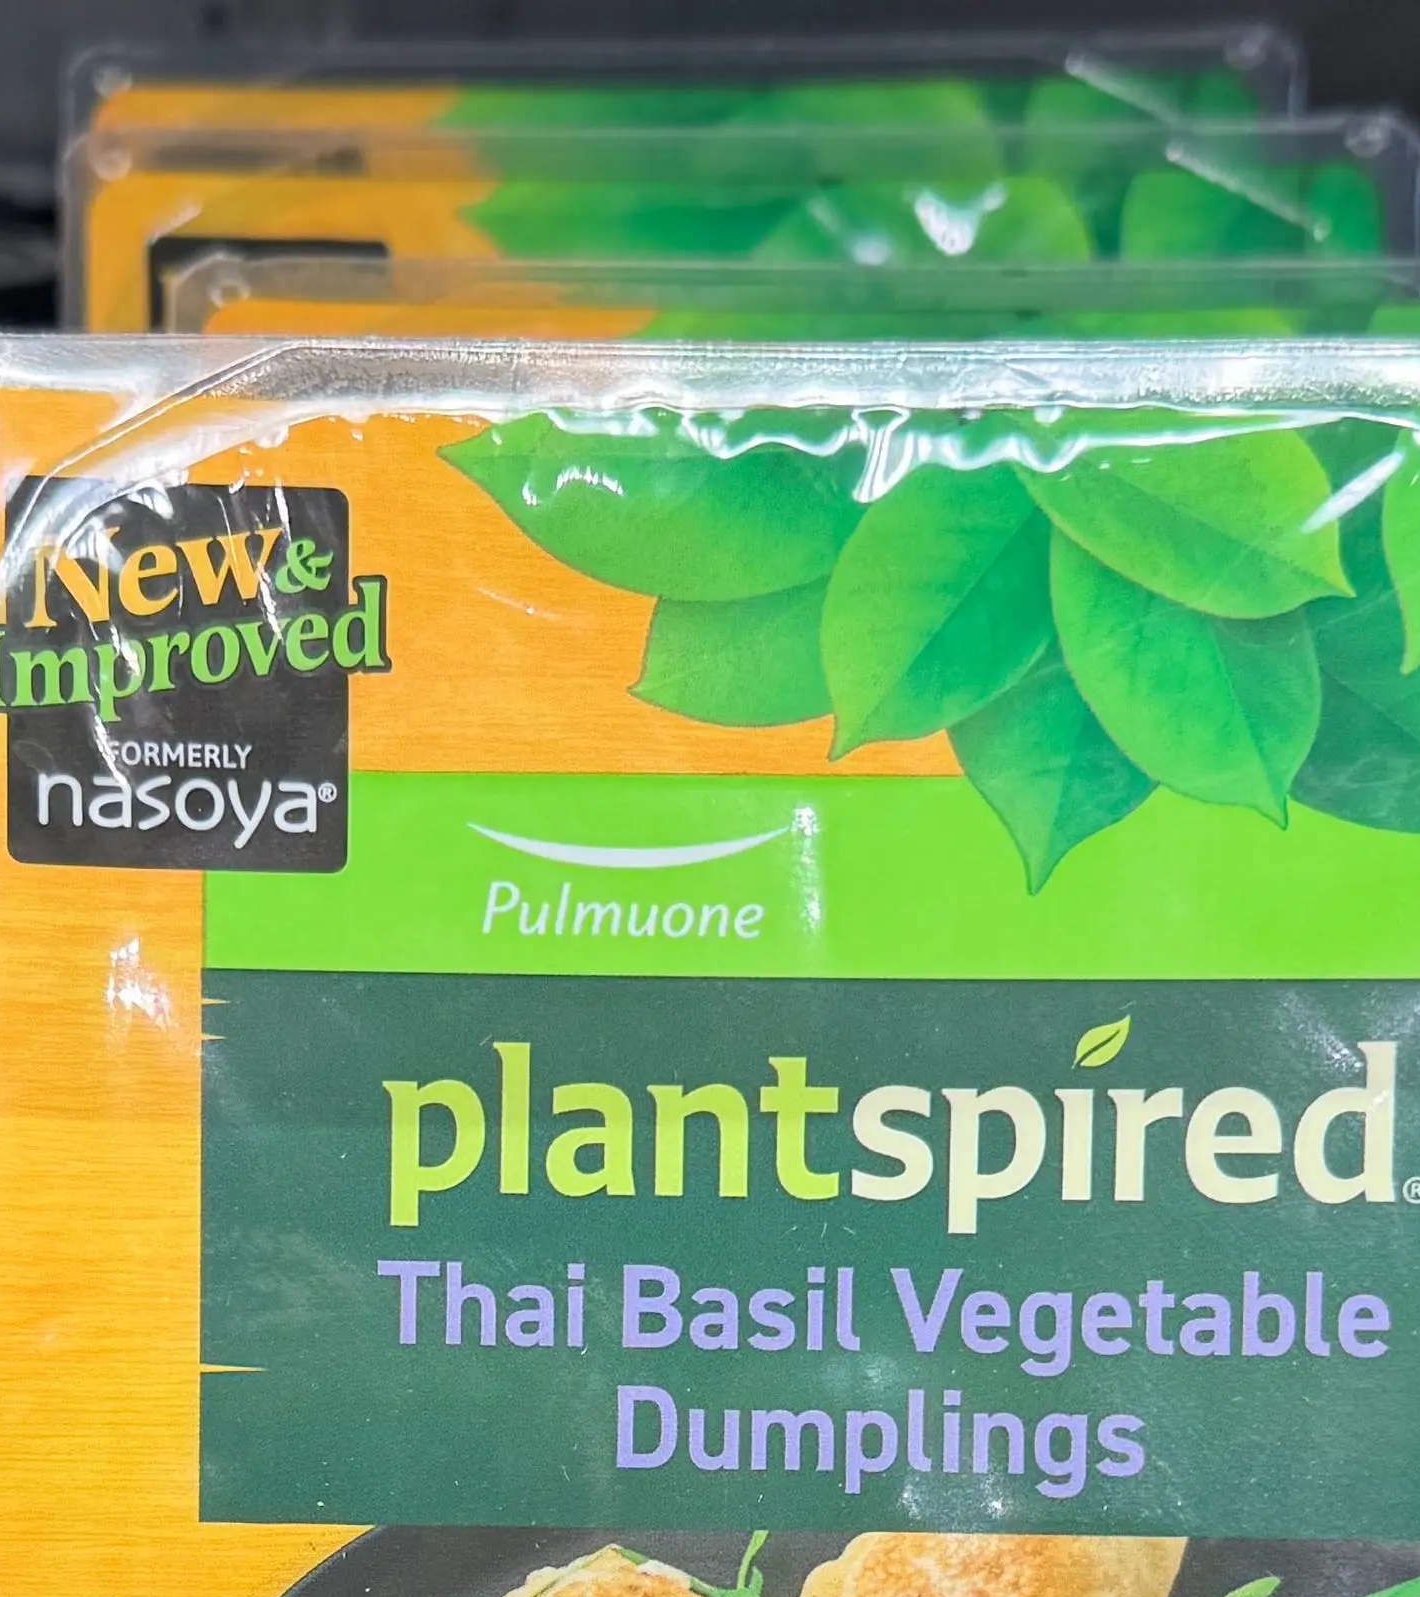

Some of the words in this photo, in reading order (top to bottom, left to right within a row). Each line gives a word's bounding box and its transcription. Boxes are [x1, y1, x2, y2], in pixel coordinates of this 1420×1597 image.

[106, 740, 253, 770] FORMERLY
[482, 880, 765, 938] Pulmuone
[378, 1259, 584, 1348] Thai
[621, 1264, 860, 1352] Basil
[890, 1265, 1393, 1377] Vegetable
[614, 1384, 1148, 1499] Dumplings
